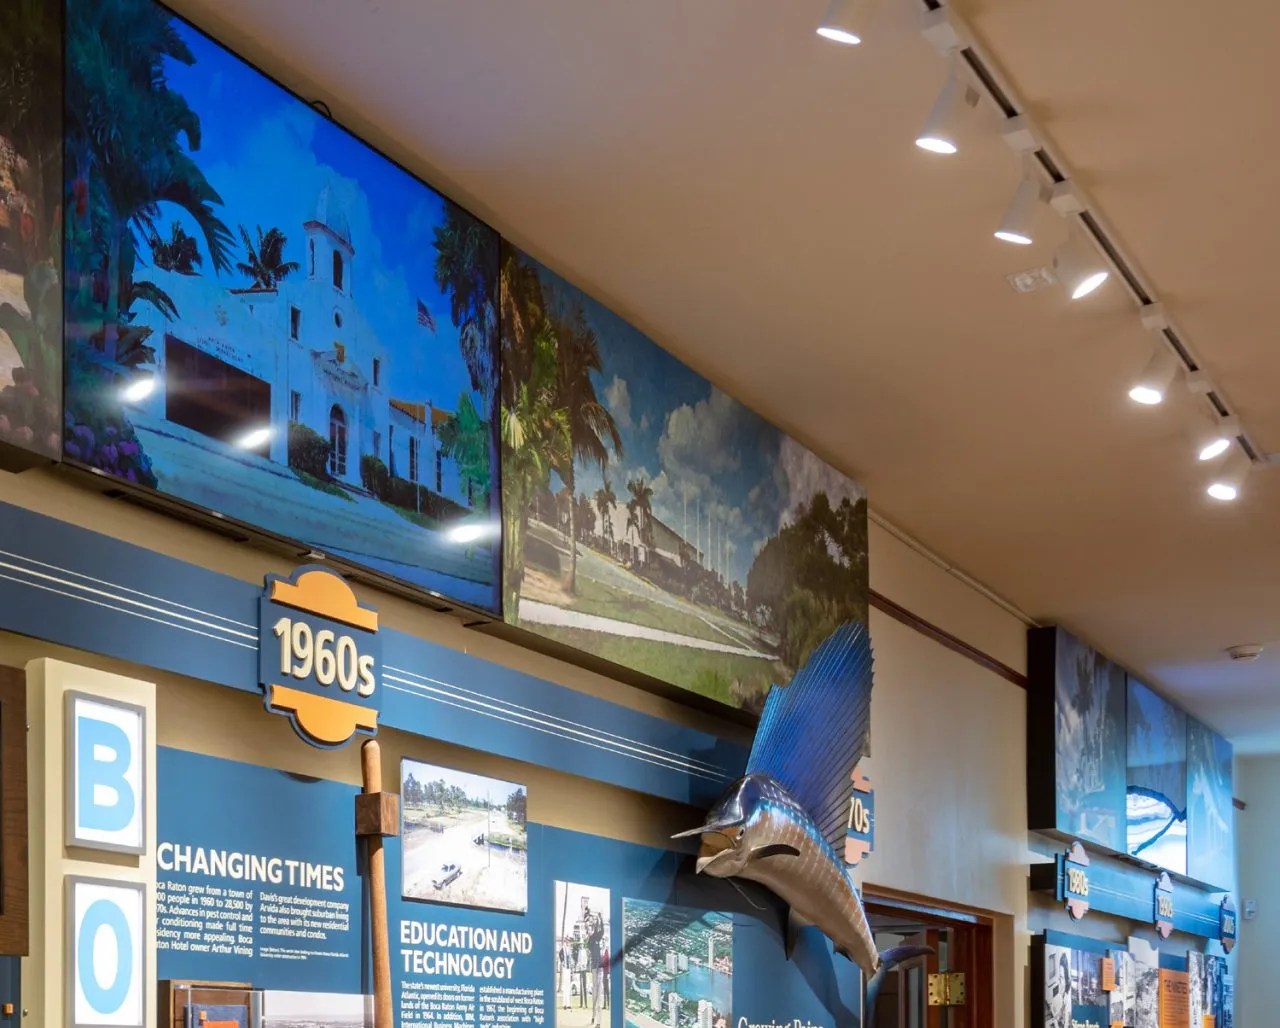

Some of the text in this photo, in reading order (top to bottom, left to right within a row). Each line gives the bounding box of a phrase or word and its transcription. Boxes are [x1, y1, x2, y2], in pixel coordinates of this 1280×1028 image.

[272, 617, 375, 695] 1960s
[157, 842, 344, 891] CHANGING TIMES
[401, 920, 532, 954] EDUCATION AND
[400, 950, 514, 979] TECHNOLOGY
